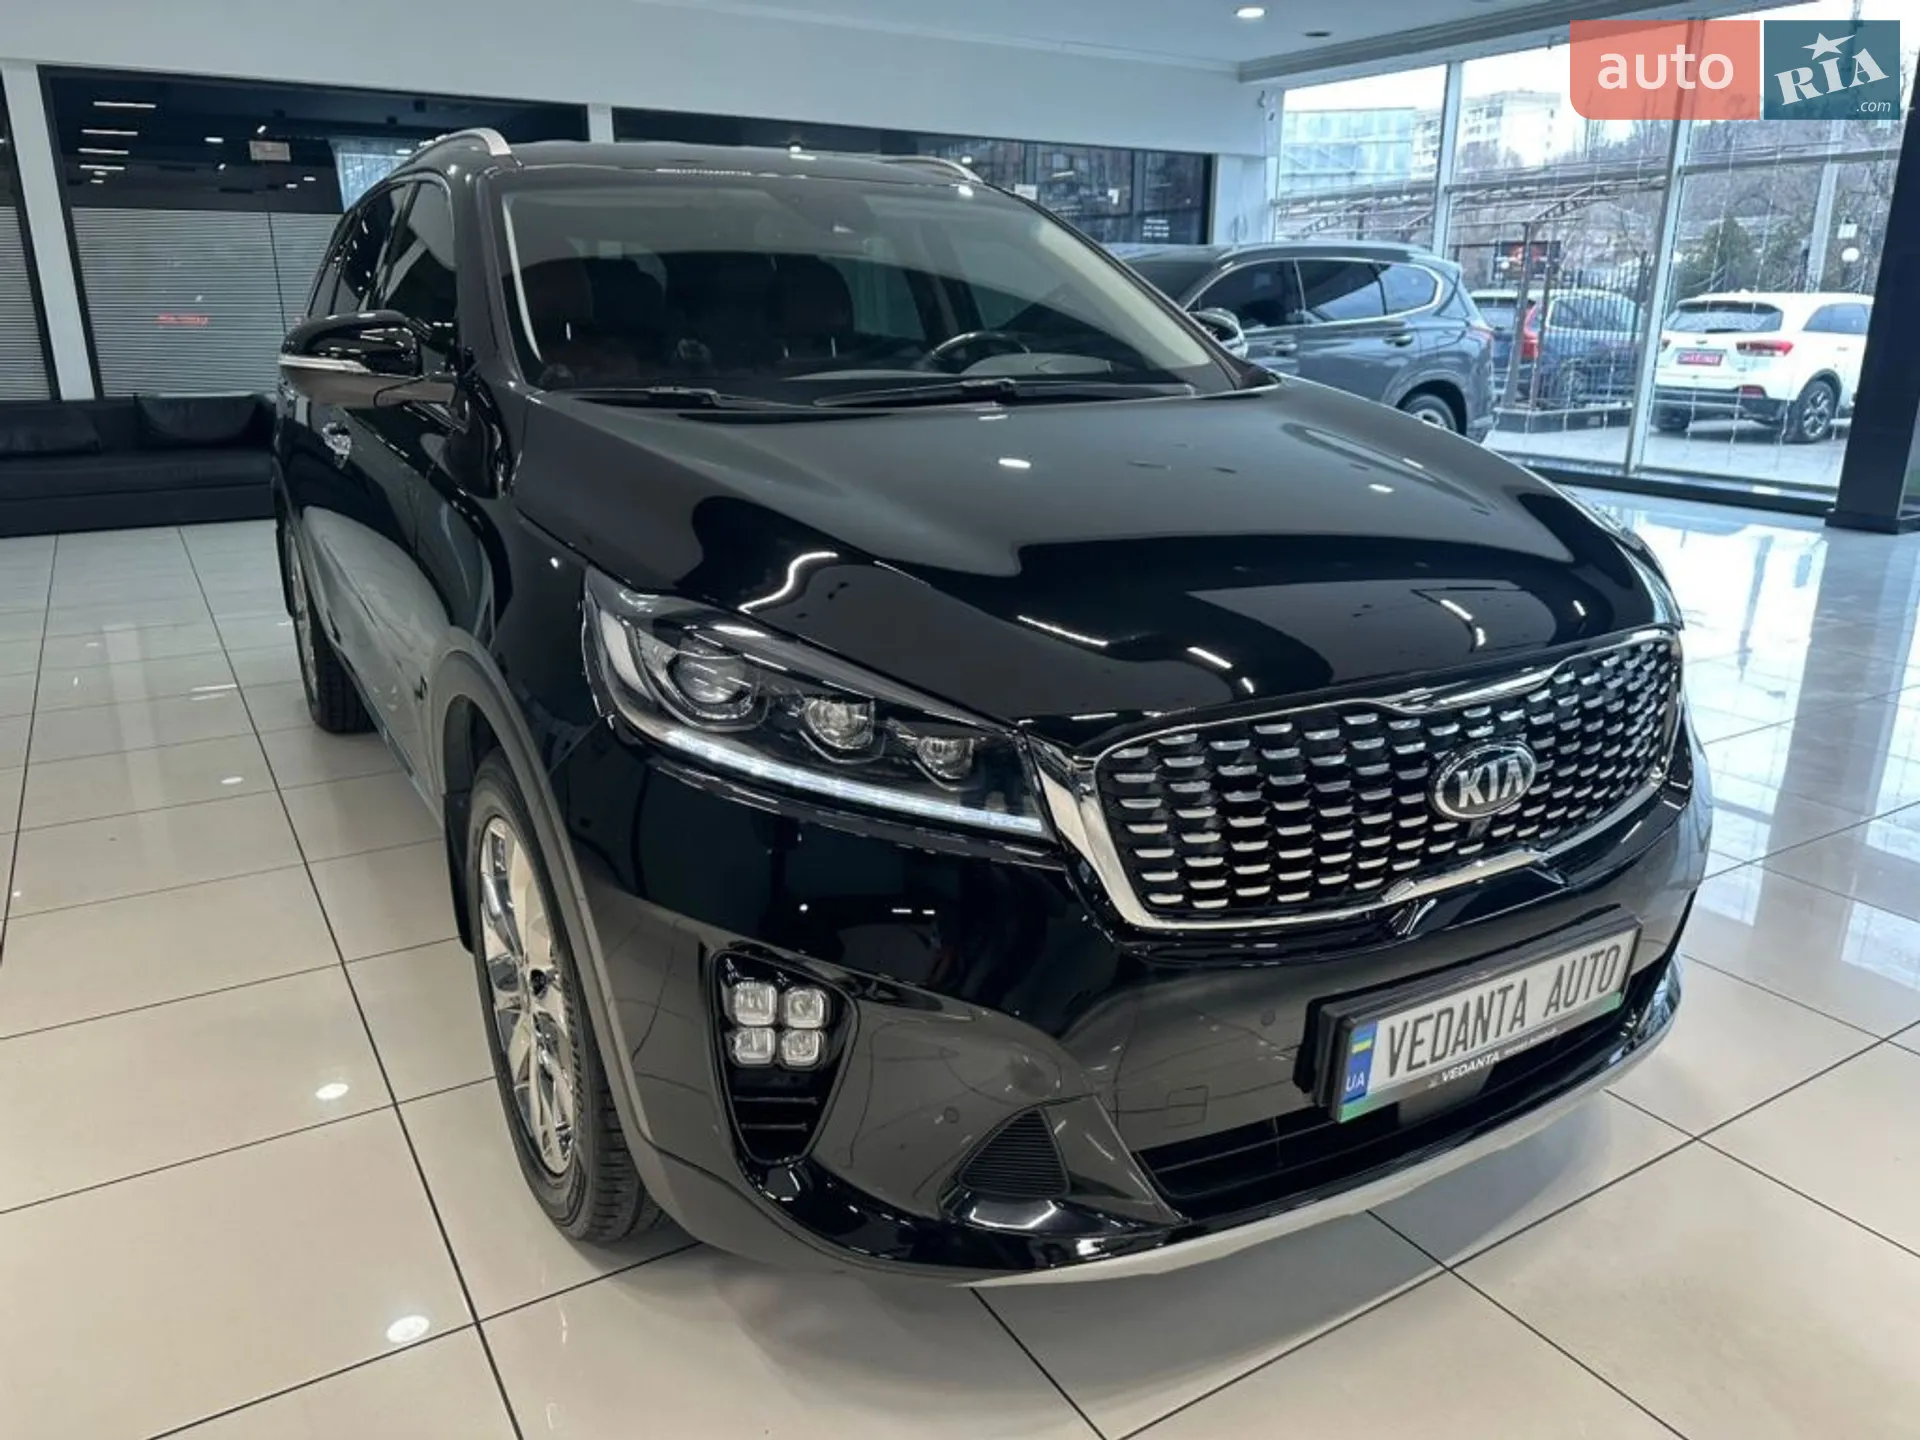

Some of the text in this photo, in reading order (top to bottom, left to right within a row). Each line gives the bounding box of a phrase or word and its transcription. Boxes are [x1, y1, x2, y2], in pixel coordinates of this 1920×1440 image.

[1456, 757, 1524, 808] KIA
[1388, 943, 1621, 1078] VEDANTA AUTO
[1346, 1071, 1365, 1092] UA
[1442, 1050, 1500, 1082] VEDANTA
